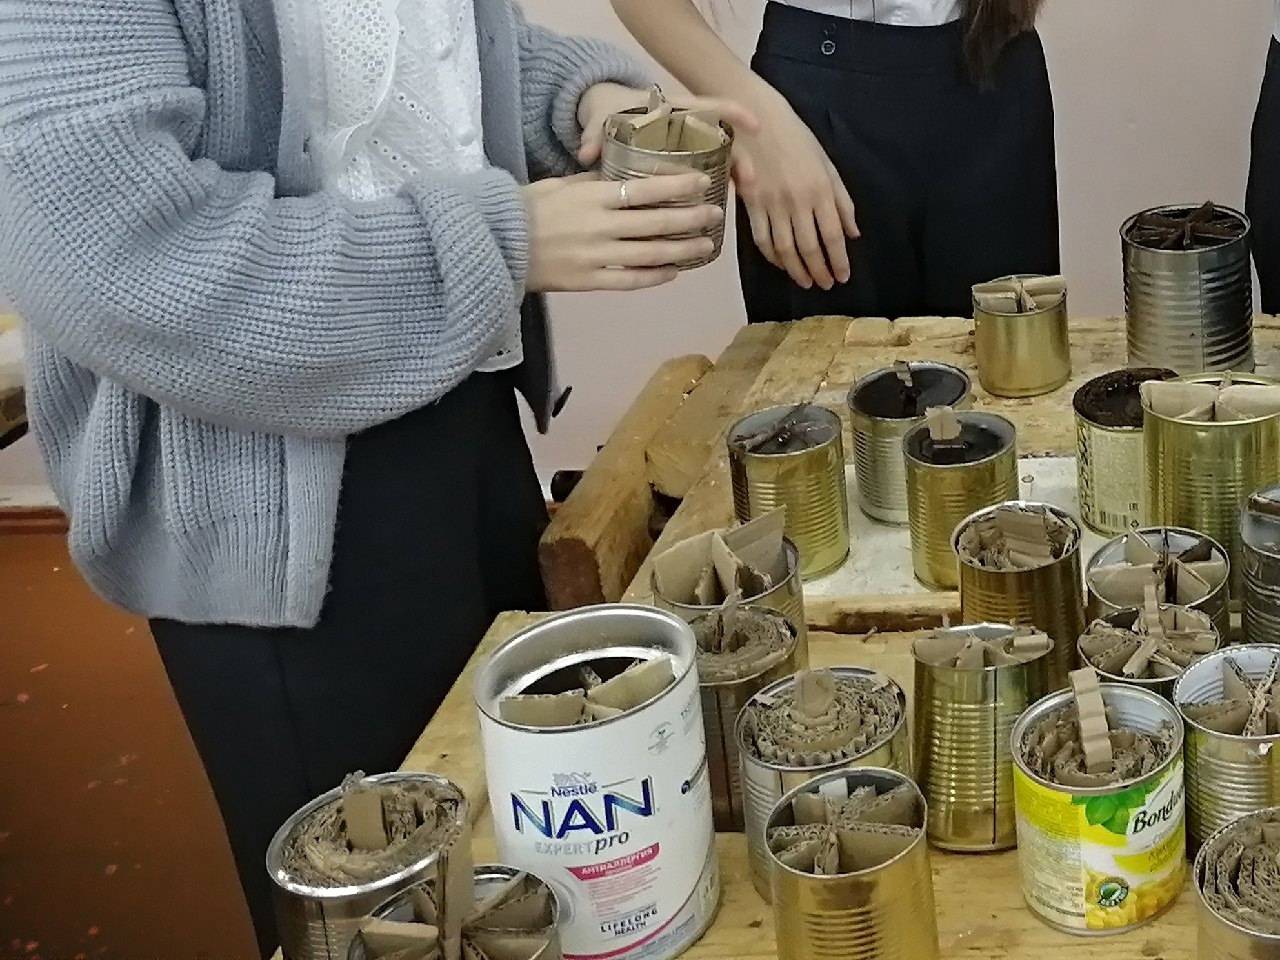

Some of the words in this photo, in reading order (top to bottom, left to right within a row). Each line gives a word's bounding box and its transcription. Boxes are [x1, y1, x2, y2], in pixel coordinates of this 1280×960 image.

[511, 775, 656, 839] NAN
[600, 907, 658, 933] LIFELONG
[614, 921, 647, 936] HEALTH
